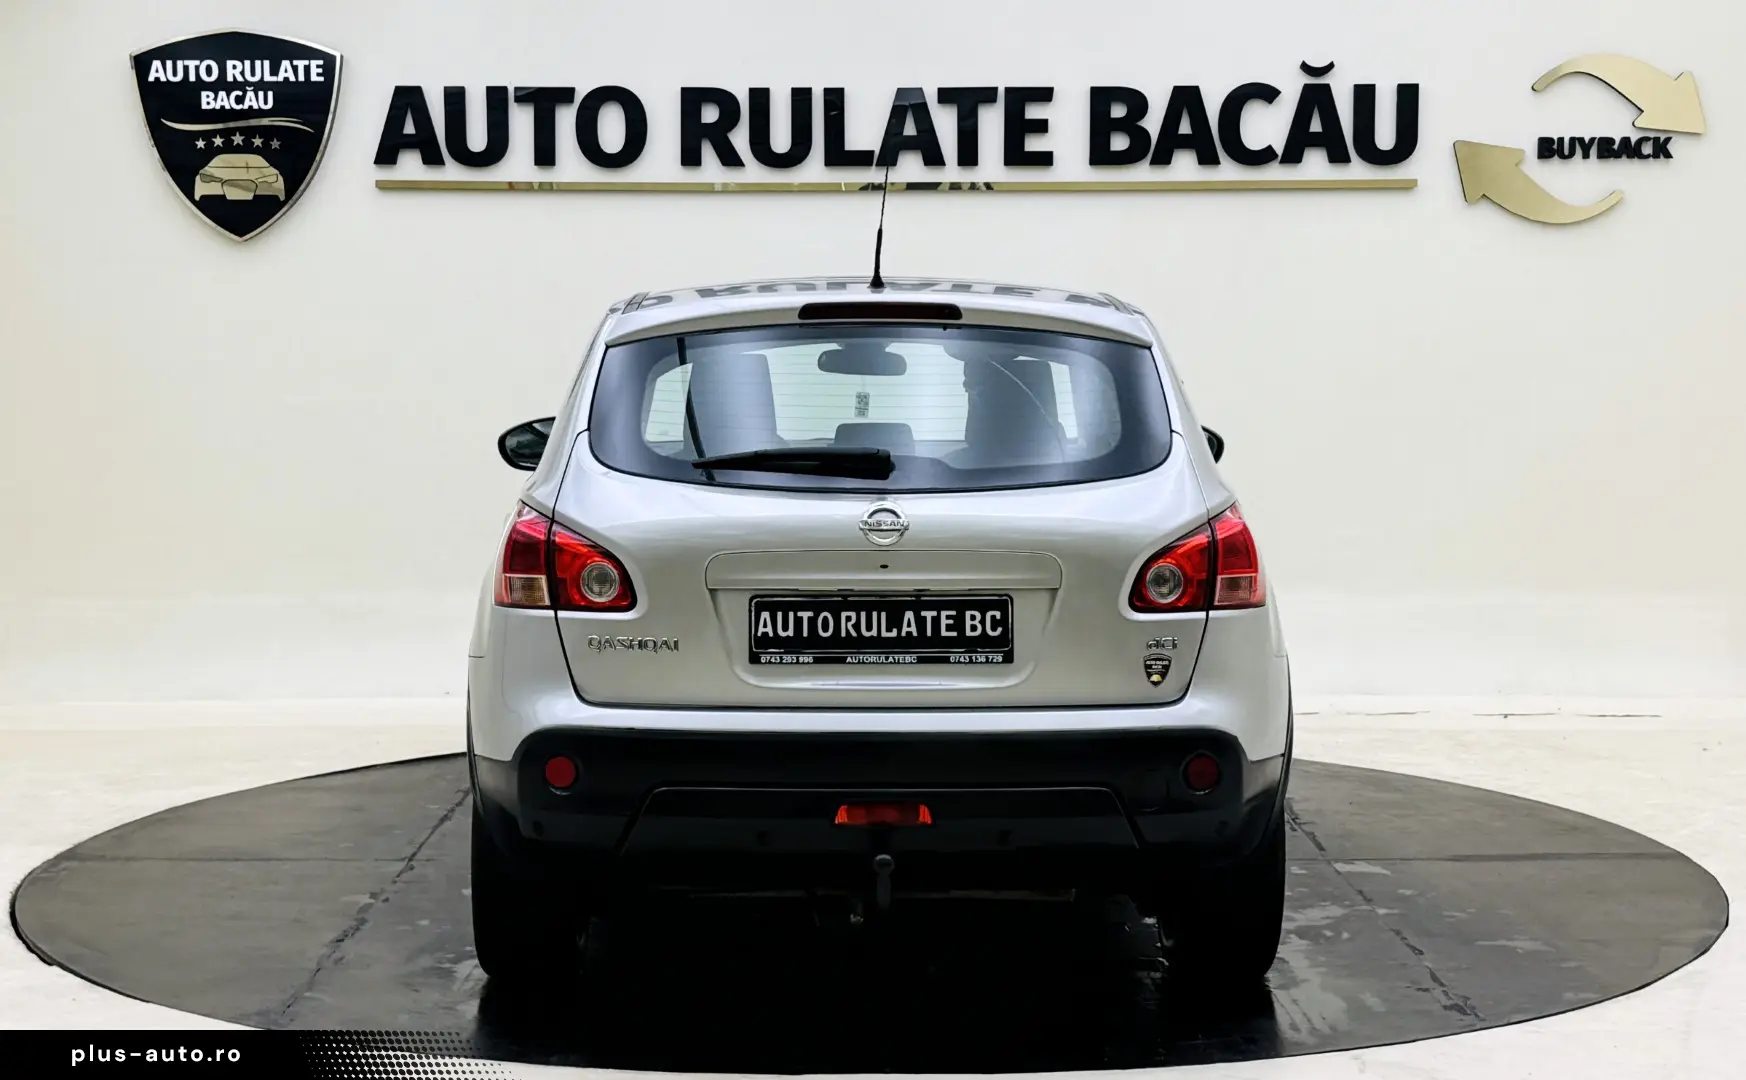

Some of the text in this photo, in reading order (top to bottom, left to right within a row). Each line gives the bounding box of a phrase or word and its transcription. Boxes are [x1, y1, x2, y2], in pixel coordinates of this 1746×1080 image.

[148, 60, 325, 83] AUTO RULATE
[200, 86, 274, 110] BACĂU
[373, 60, 1420, 169] AUTO RULATE BACĂU
[1537, 136, 1673, 161] BUYBACK
[864, 520, 905, 528] NISSAN
[757, 610, 1003, 638] AUTO RULATE BC
[588, 635, 679, 654] QASHQAI
[760, 656, 781, 664] 0743
[846, 656, 918, 664] AUTORULATEBC
[950, 655, 970, 663] 0743
